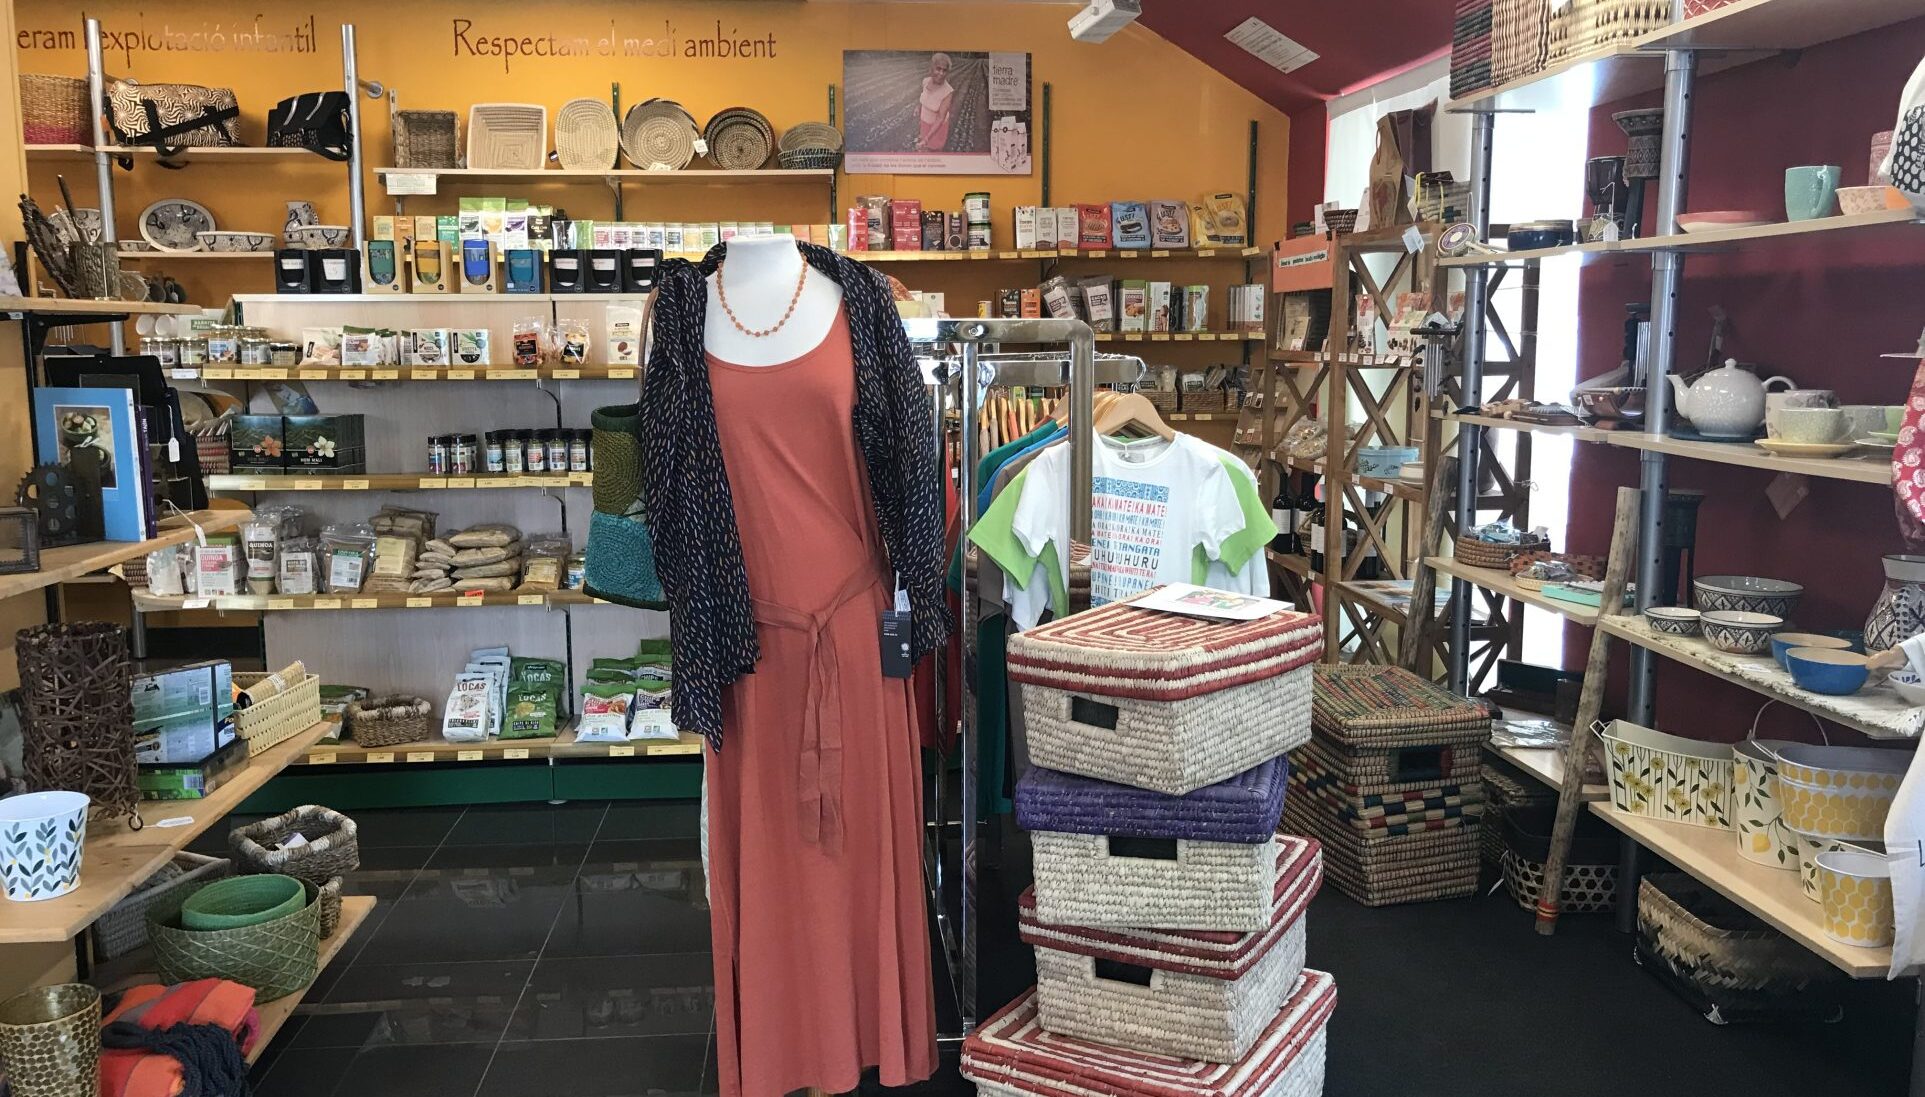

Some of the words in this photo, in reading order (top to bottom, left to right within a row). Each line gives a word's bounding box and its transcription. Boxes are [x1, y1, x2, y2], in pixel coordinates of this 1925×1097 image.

[452, 18, 591, 75] Respectam
[598, 18, 616, 58] el
[623, 19, 678, 59] medi
[684, 18, 778, 60] ambient
[992, 76, 1018, 87] madre
[457, 682, 487, 692] LOCAS
